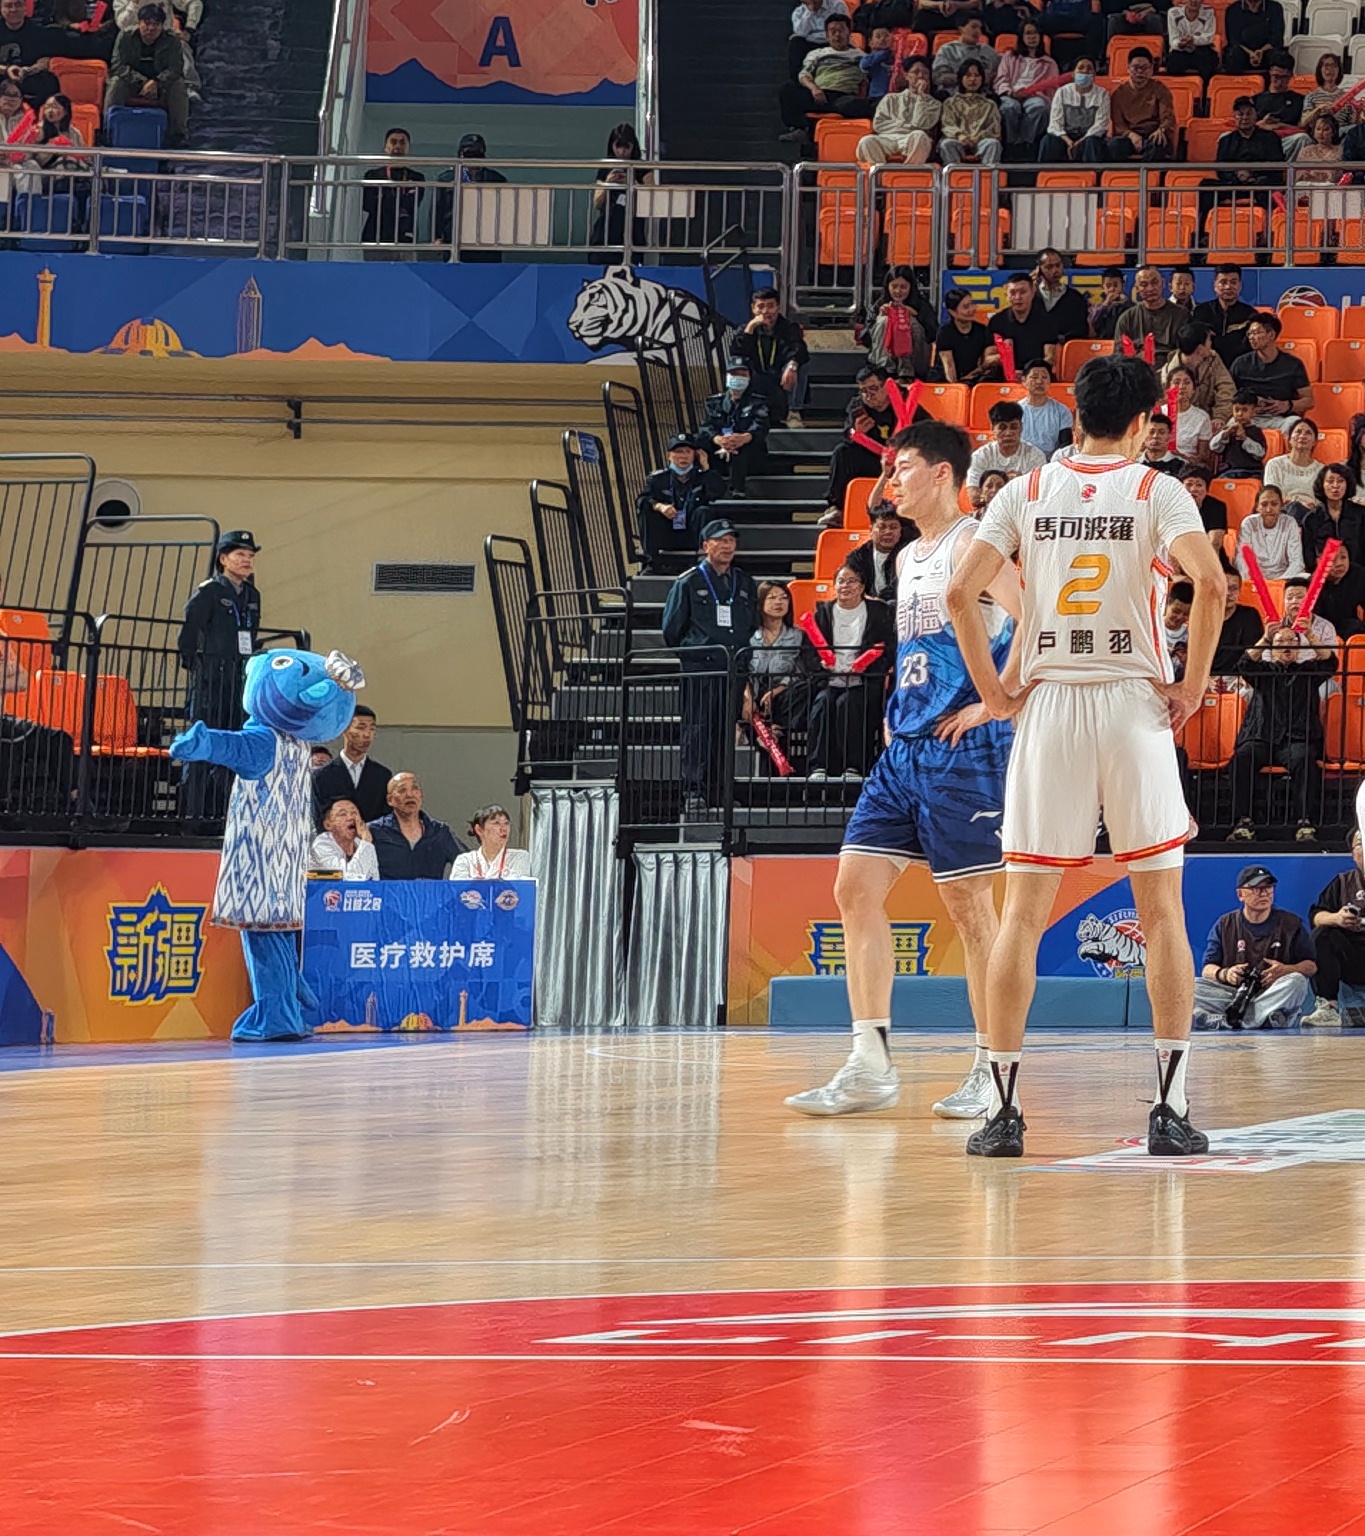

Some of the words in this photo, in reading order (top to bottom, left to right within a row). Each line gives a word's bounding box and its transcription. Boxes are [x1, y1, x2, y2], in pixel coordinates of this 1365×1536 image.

[479, 15, 522, 69] A
[1034, 516, 1135, 542] 馬可波羅
[1056, 553, 1111, 617] 2
[900, 651, 930, 688] 23
[113, 910, 198, 990] 新疆
[351, 940, 496, 970] 医疗救护席
